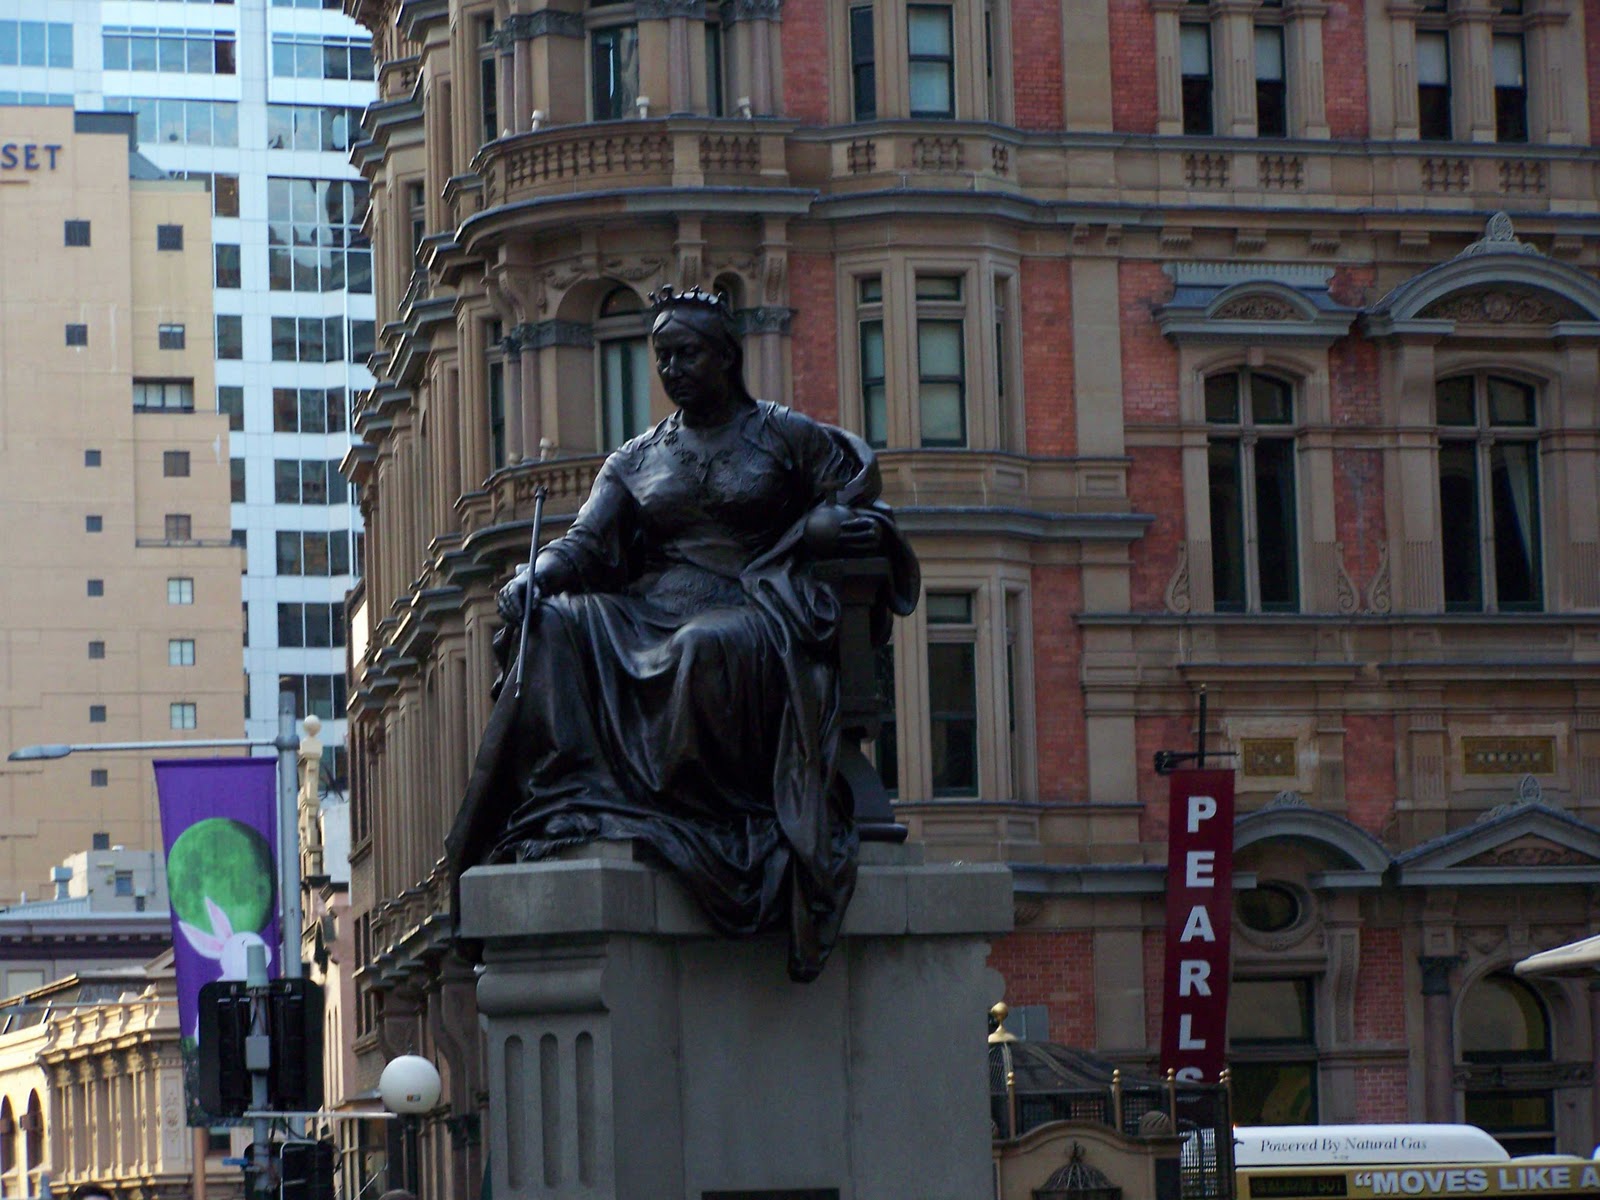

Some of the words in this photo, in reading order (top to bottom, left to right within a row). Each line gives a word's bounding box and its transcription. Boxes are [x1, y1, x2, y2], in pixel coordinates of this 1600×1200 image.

[1, 143, 62, 171] SET
[1260, 1138, 1318, 1153] Powered
[1322, 1137, 1341, 1154] By
[1345, 1136, 1398, 1151] Natural
[1401, 1136, 1428, 1151] Gas
[1499, 1166, 1572, 1190] LIKE
